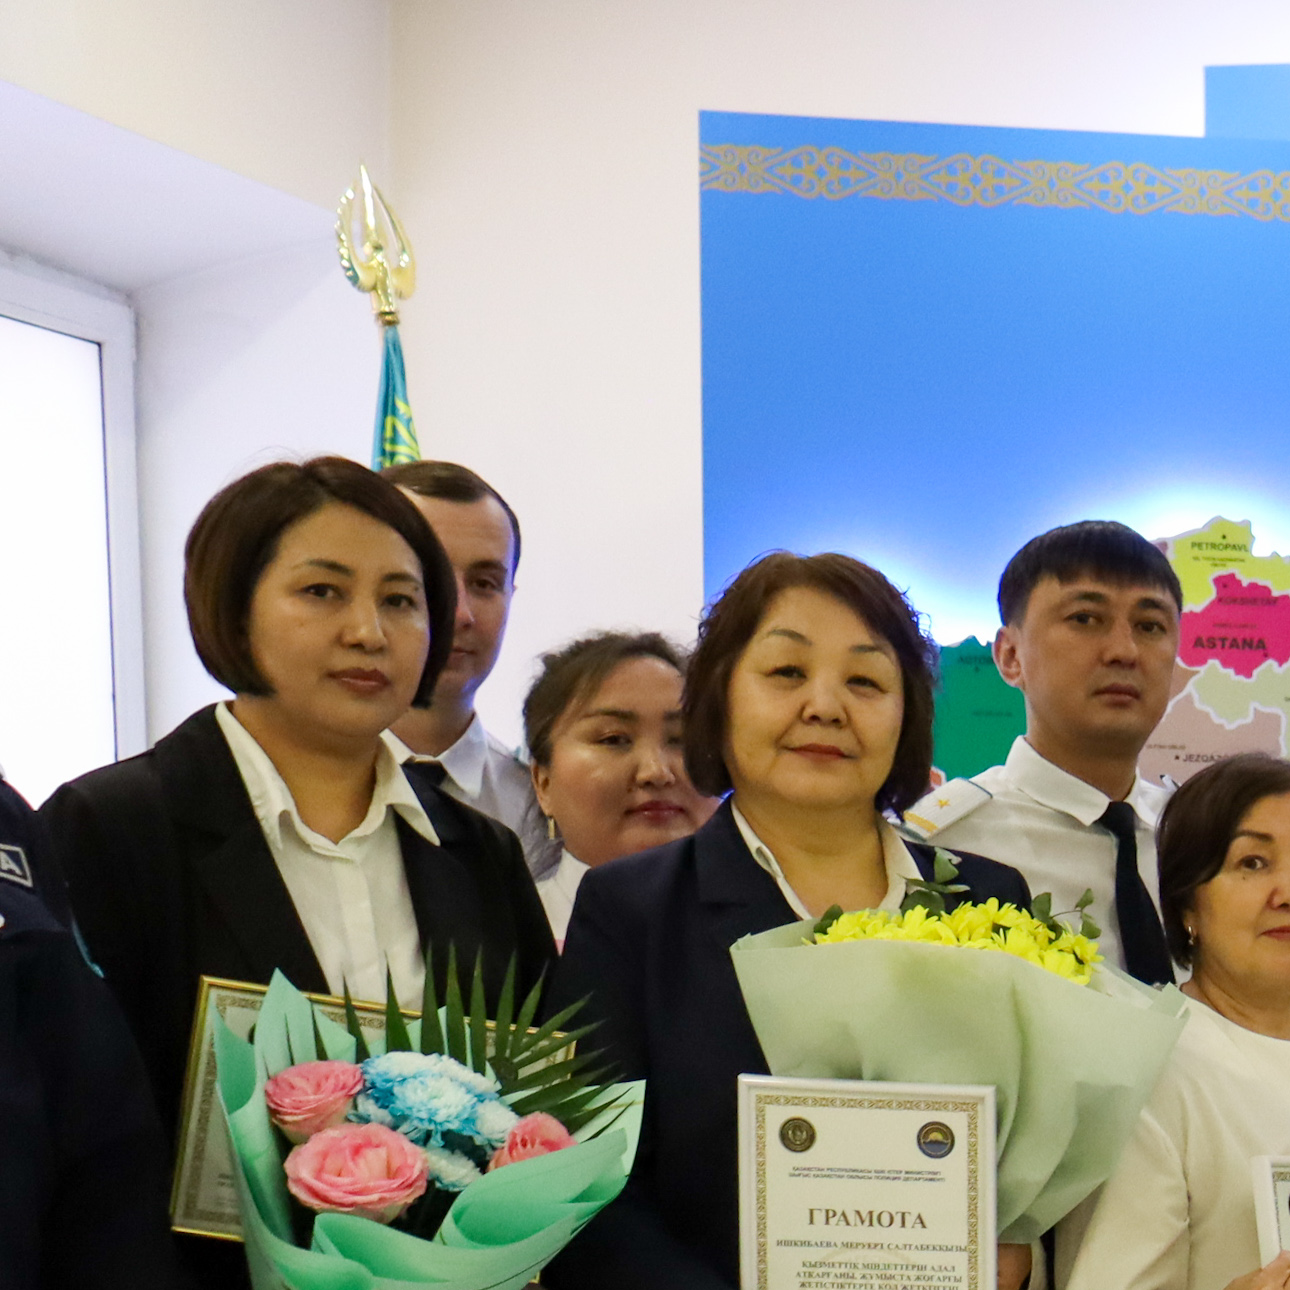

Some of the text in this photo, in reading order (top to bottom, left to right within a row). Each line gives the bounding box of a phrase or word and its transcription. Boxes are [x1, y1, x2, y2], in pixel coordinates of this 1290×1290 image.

[1191, 541, 1249, 552] PETROPAVL
[1193, 636, 1267, 650] ASTANA
[808, 1208, 927, 1229] ГРАМОТА
